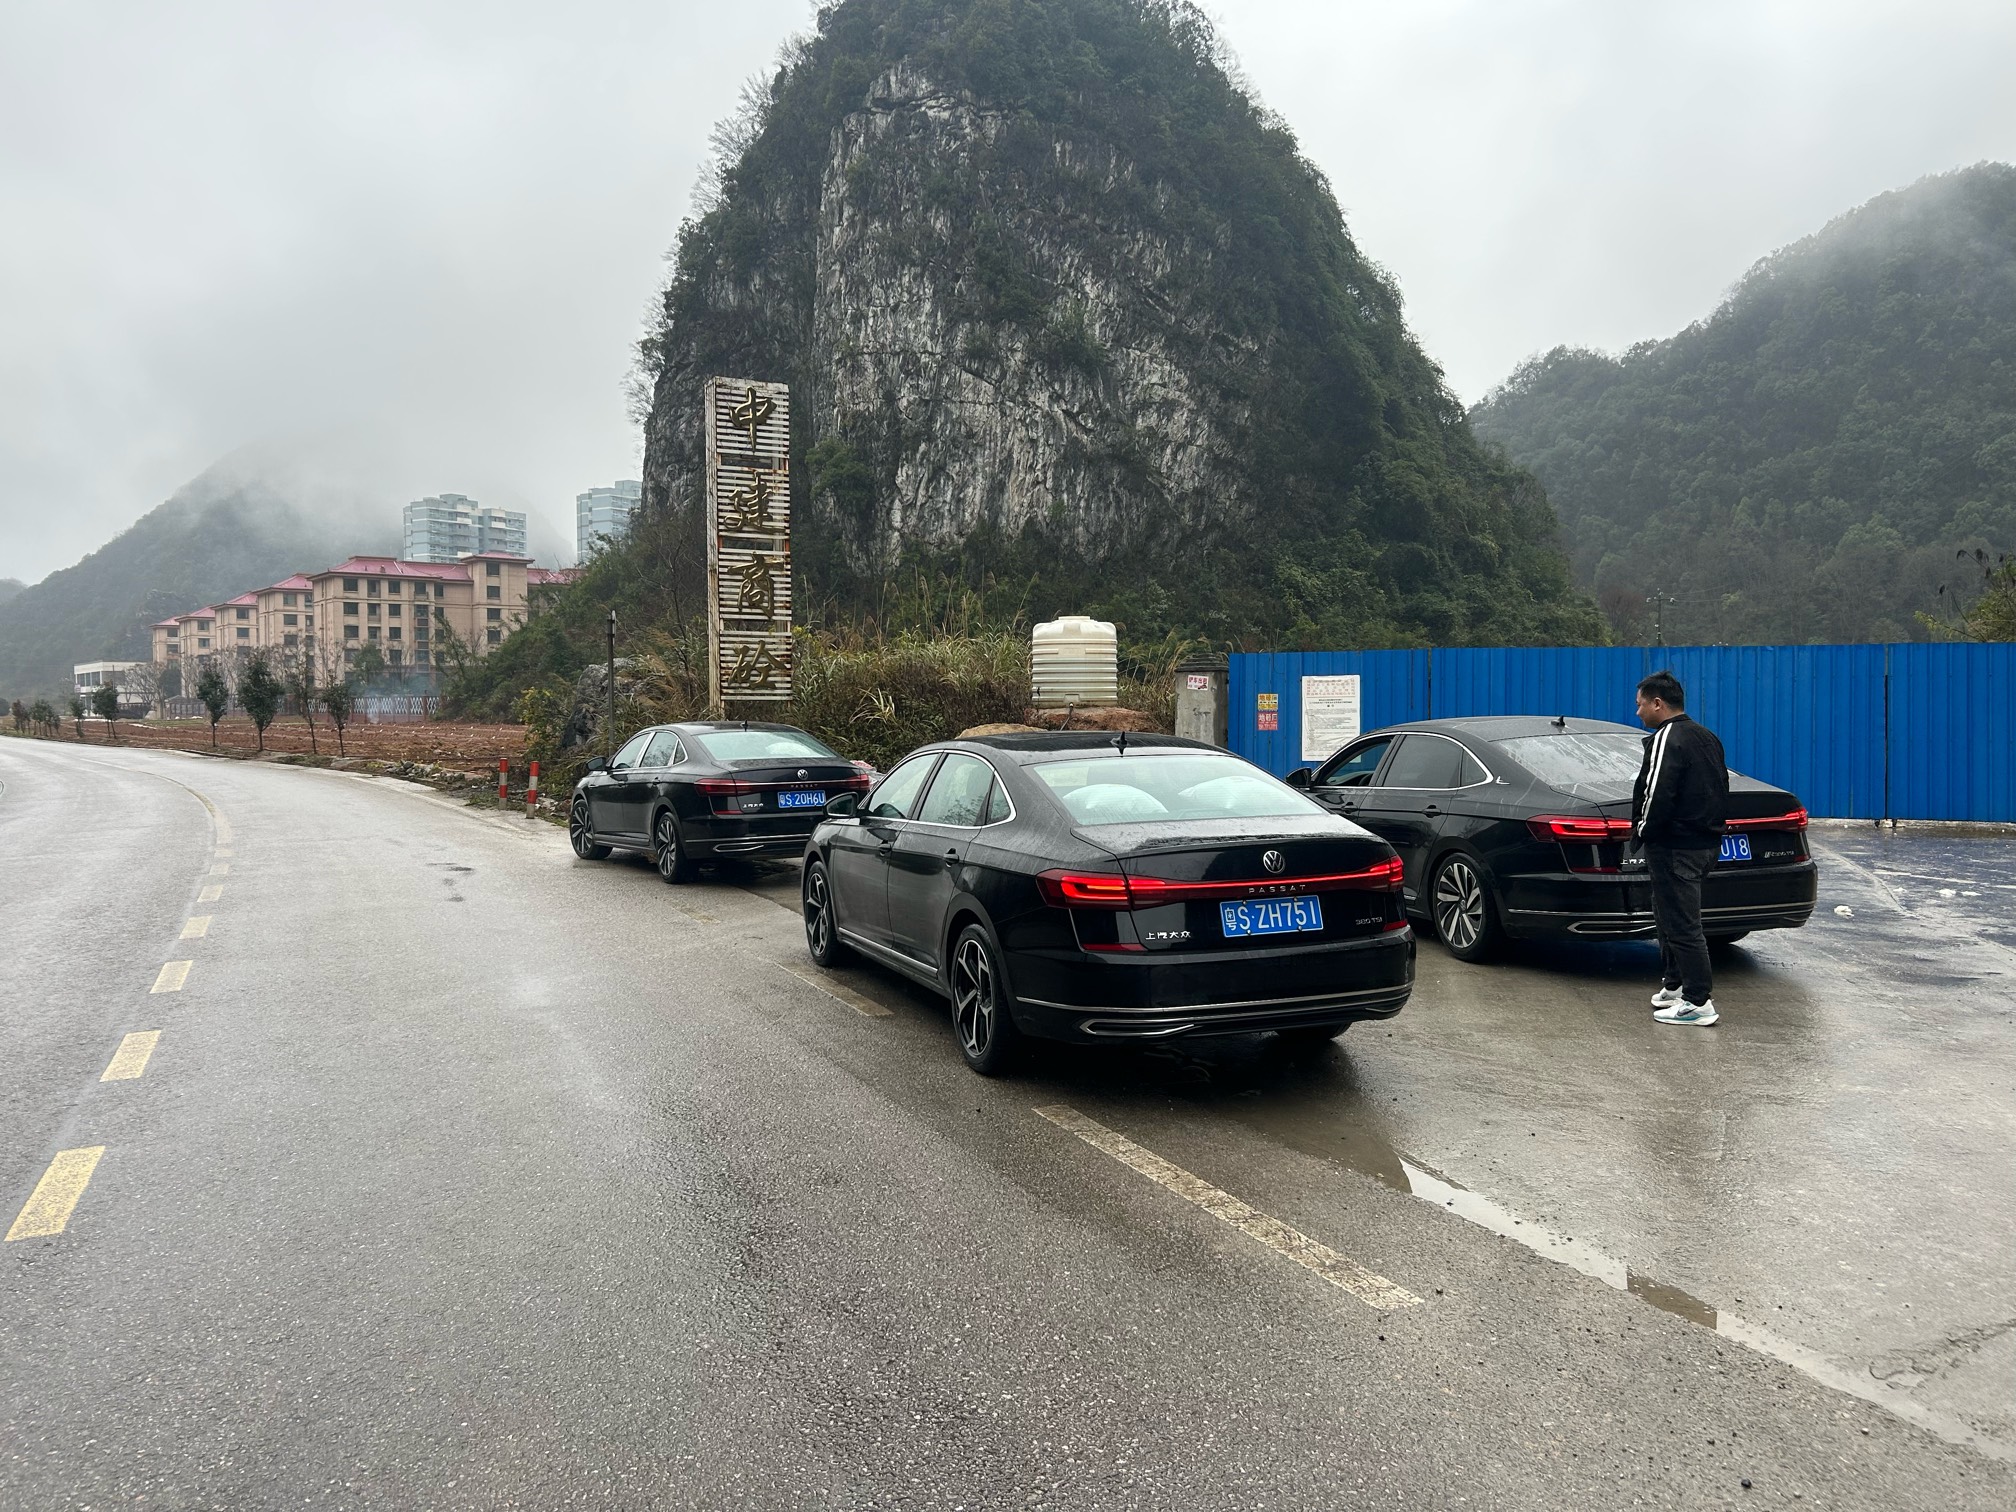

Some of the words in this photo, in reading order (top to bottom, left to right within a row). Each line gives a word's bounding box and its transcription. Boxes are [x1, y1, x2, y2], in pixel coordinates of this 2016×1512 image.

[1248, 884, 1306, 894] PASSAT
[1145, 930, 1191, 940] 上汽大众
